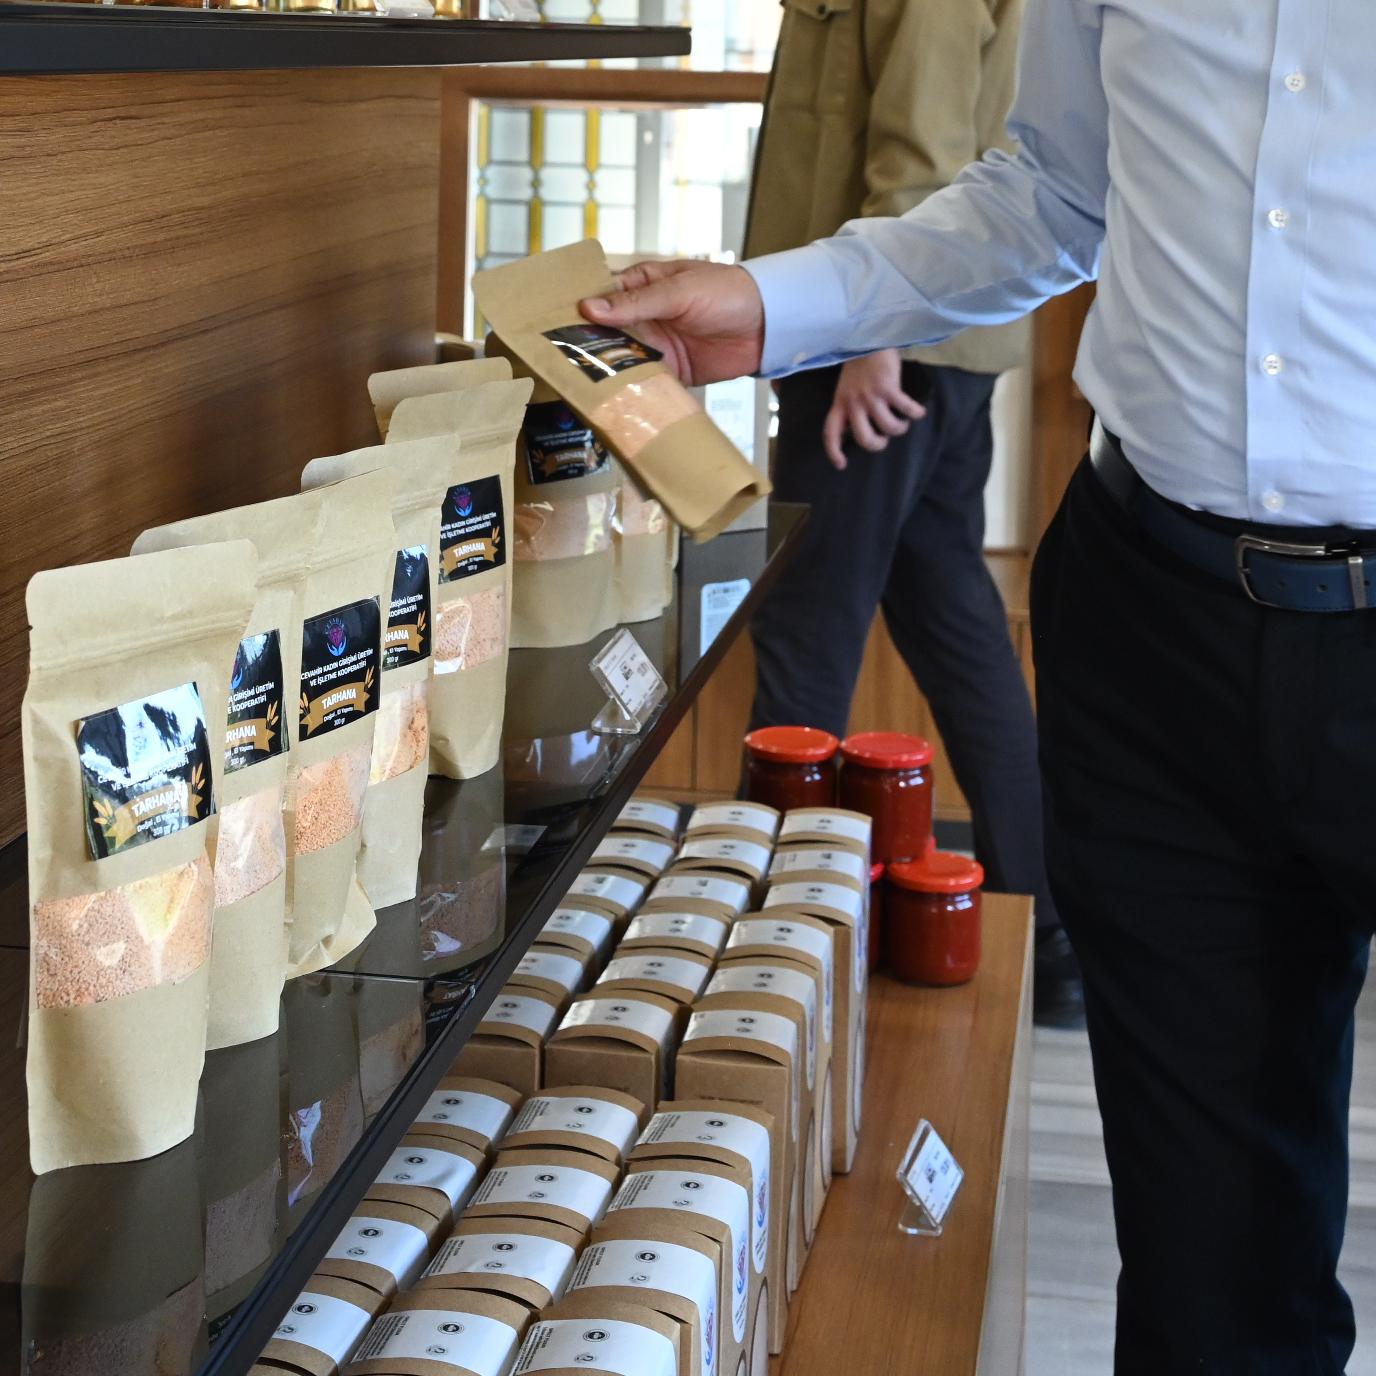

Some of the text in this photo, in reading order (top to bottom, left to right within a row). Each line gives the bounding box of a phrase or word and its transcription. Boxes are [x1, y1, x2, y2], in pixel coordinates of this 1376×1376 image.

[453, 542, 486, 557] TARHANA
[309, 678, 317, 687] VE
[321, 688, 356, 709] TARHANA
[225, 725, 257, 743] RHANA
